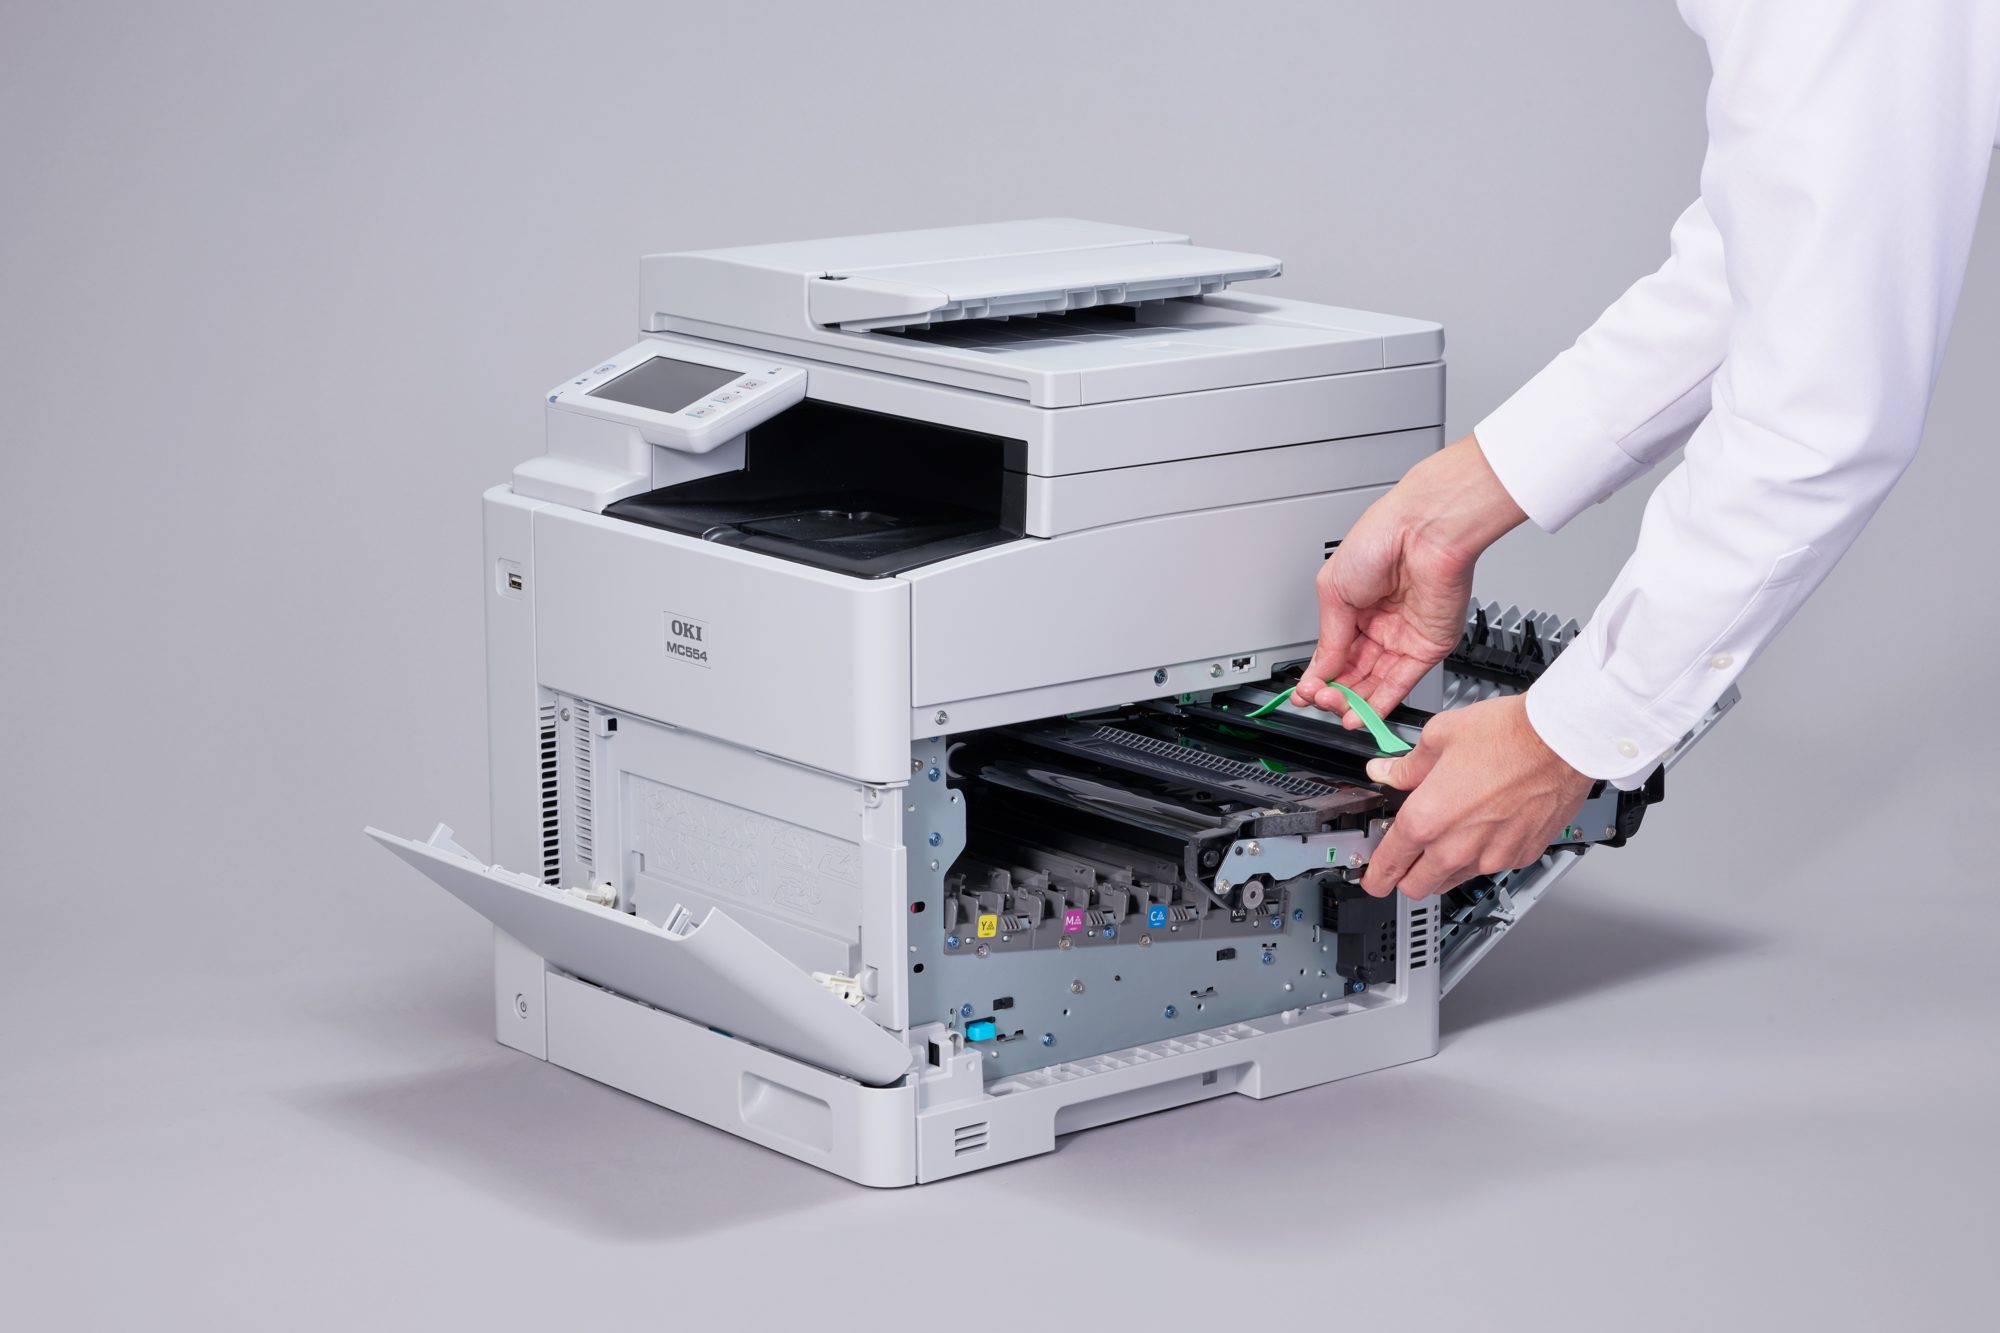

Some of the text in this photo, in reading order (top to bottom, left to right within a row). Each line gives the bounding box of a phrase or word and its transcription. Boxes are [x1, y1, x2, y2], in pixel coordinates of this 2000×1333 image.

[671, 619, 702, 642] OKI
[666, 641, 708, 663] MC554
[1065, 915, 1074, 926] M
[1150, 911, 1157, 921] C
[981, 920, 987, 931] Y
